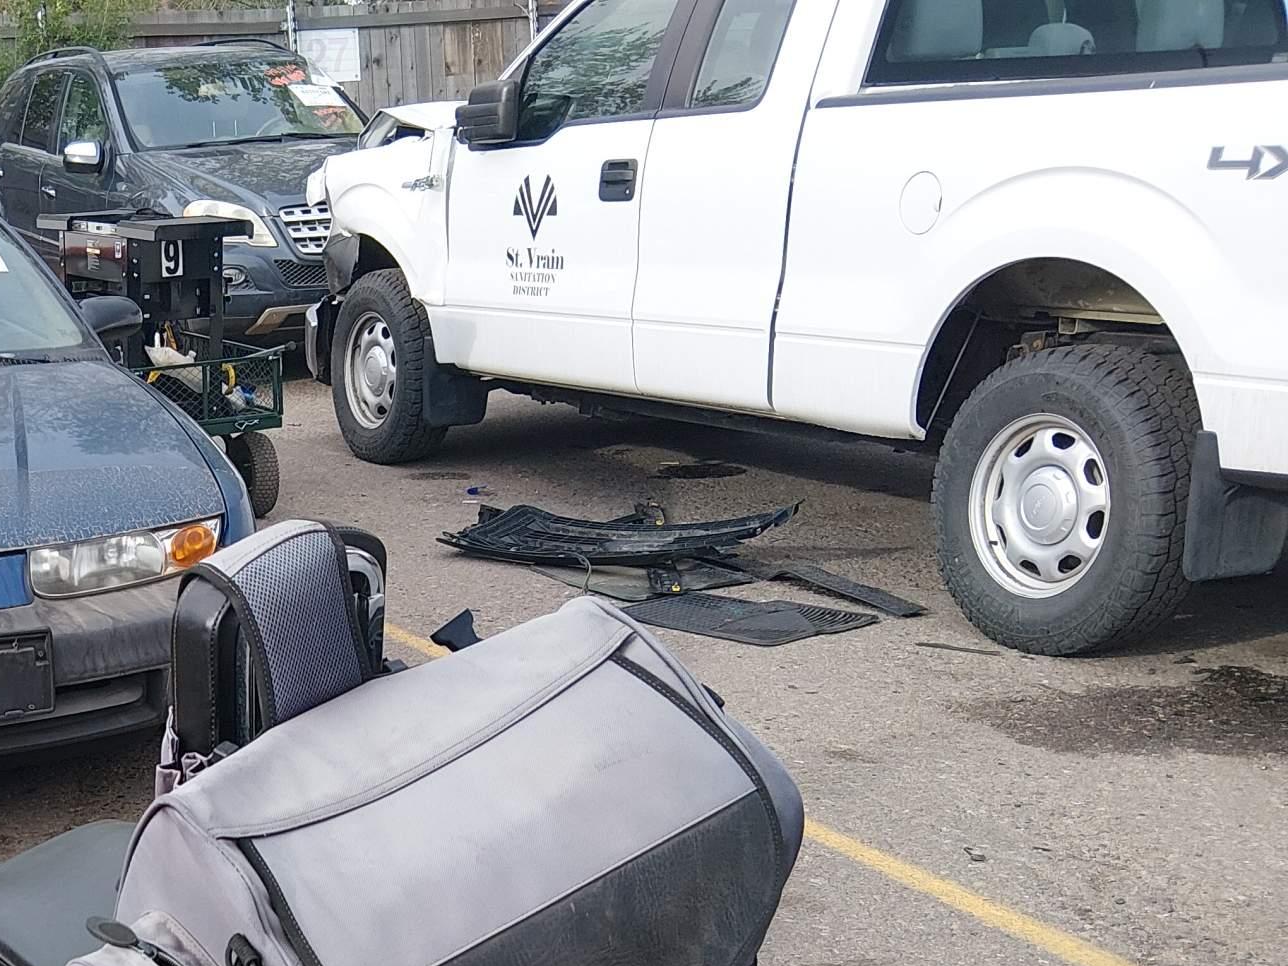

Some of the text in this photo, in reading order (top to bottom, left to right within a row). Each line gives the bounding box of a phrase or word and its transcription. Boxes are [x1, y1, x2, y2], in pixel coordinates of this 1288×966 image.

[164, 240, 180, 275] 9
[505, 246, 564, 270] St. Vrain
[510, 271, 557, 284] SANITATION
[513, 285, 551, 297] DISTRICT
